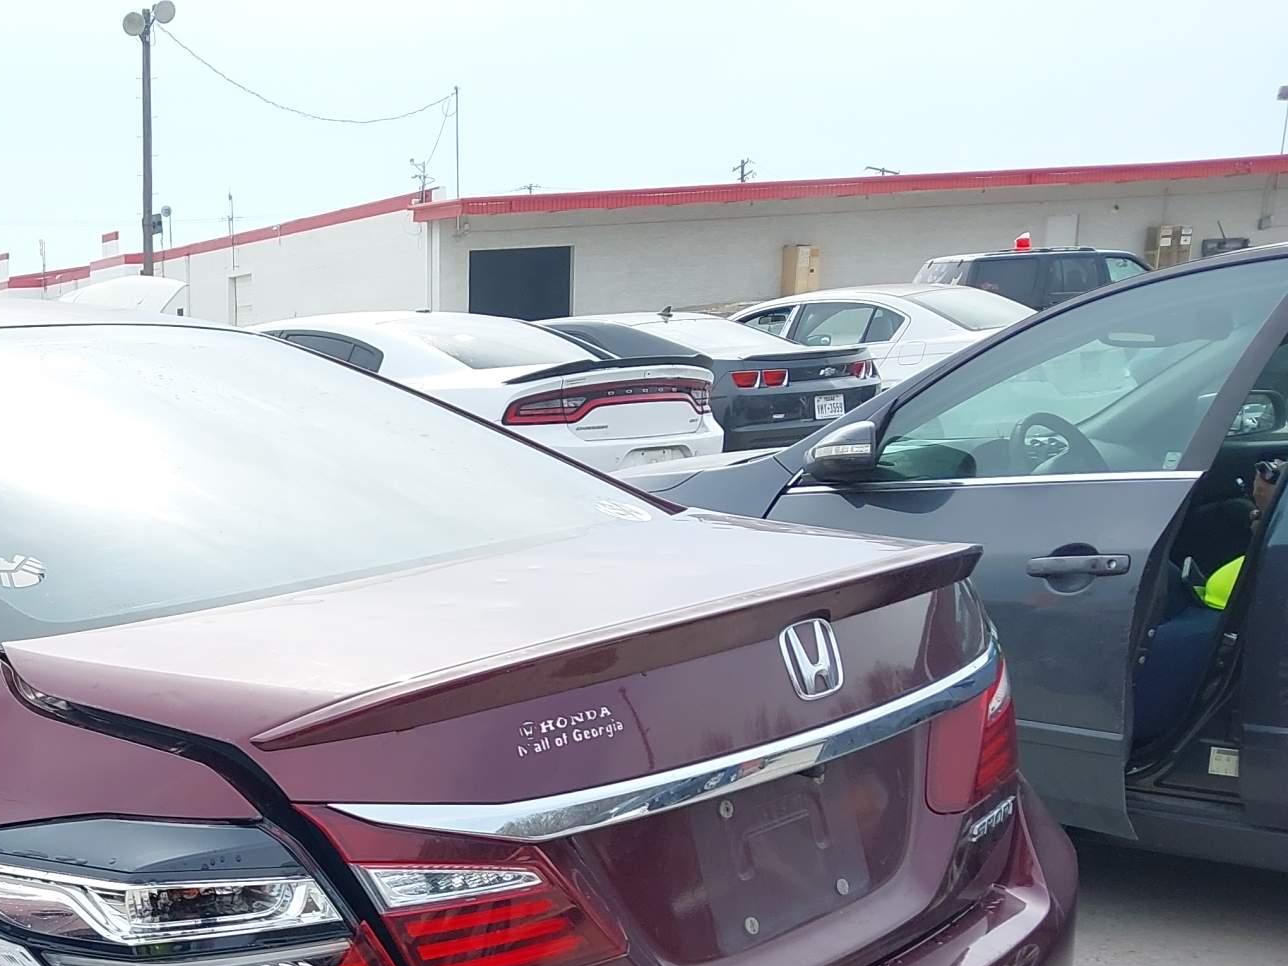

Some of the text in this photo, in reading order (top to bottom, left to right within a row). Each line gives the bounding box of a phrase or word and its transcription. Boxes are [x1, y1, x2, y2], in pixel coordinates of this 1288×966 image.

[539, 706, 612, 733] HONDA
[554, 732, 568, 747] of
[572, 718, 624, 742] Georgia
